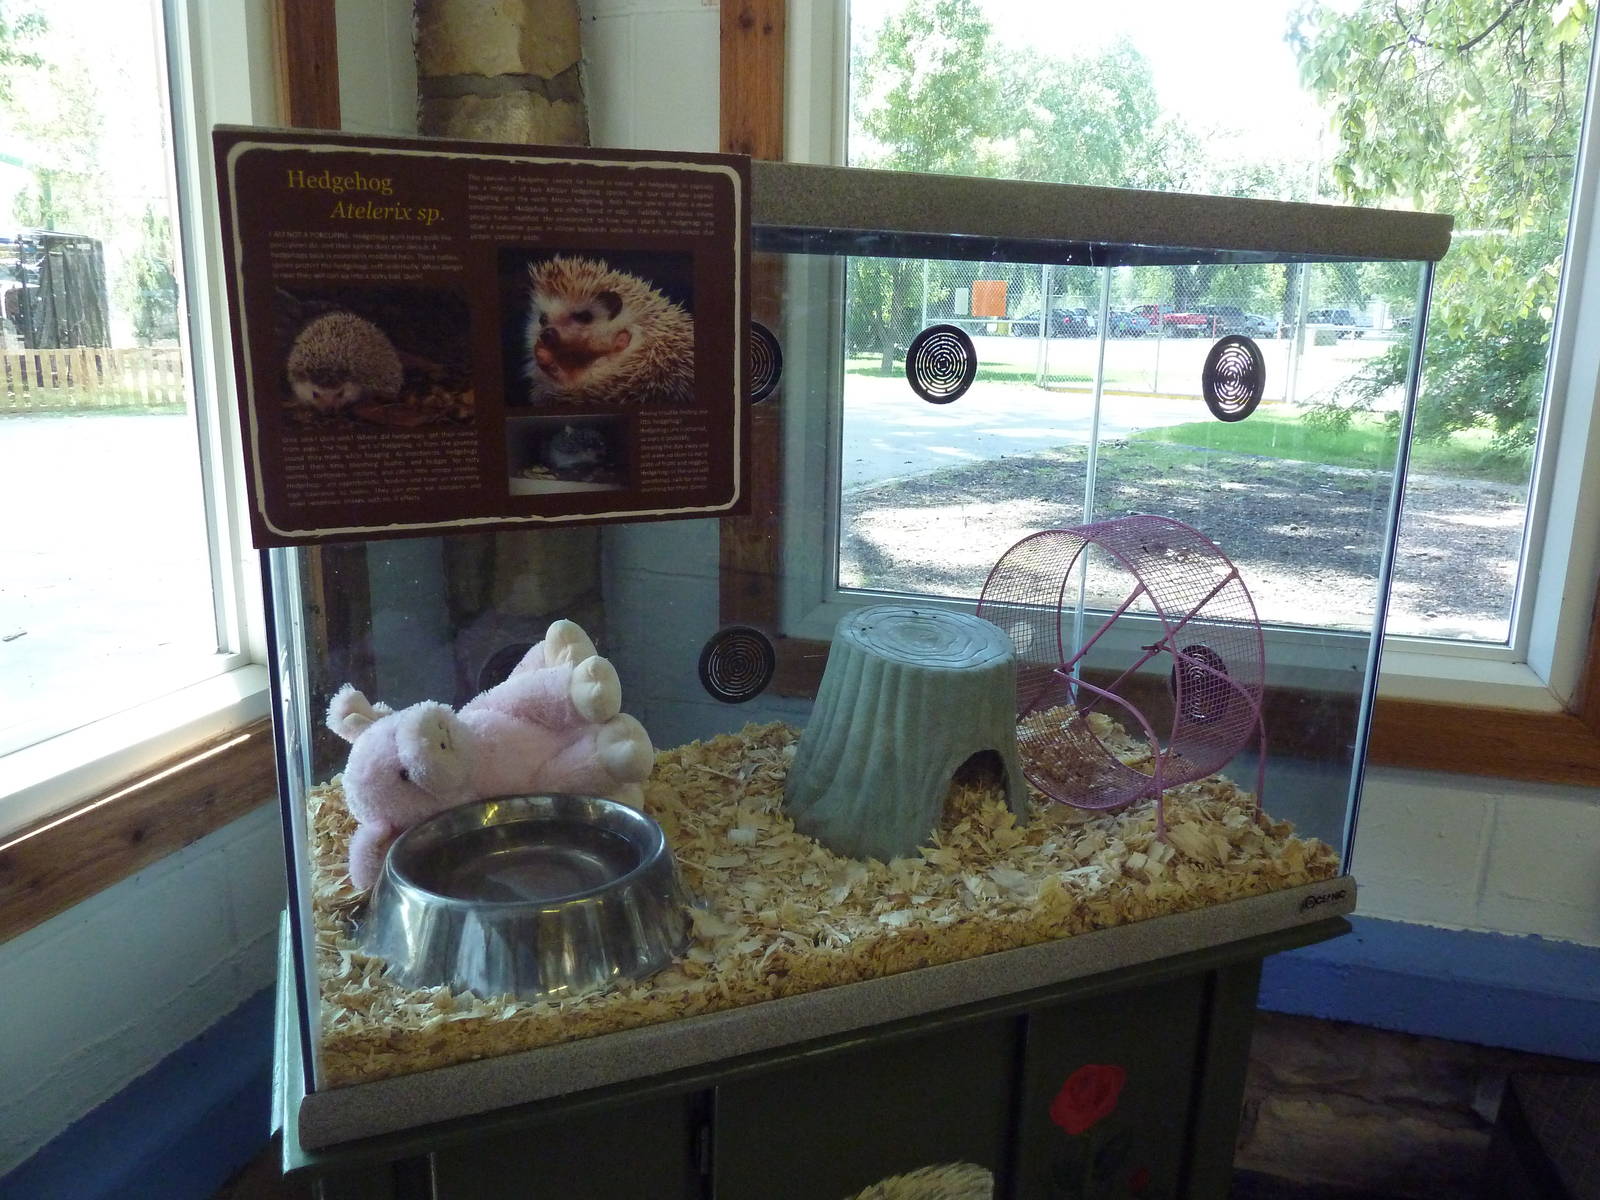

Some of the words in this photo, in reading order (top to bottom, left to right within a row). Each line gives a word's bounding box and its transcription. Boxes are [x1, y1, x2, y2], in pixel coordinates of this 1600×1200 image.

[288, 169, 393, 195] Hedgehog
[329, 201, 412, 220] Atelerix
[416, 207, 446, 225] sp.
